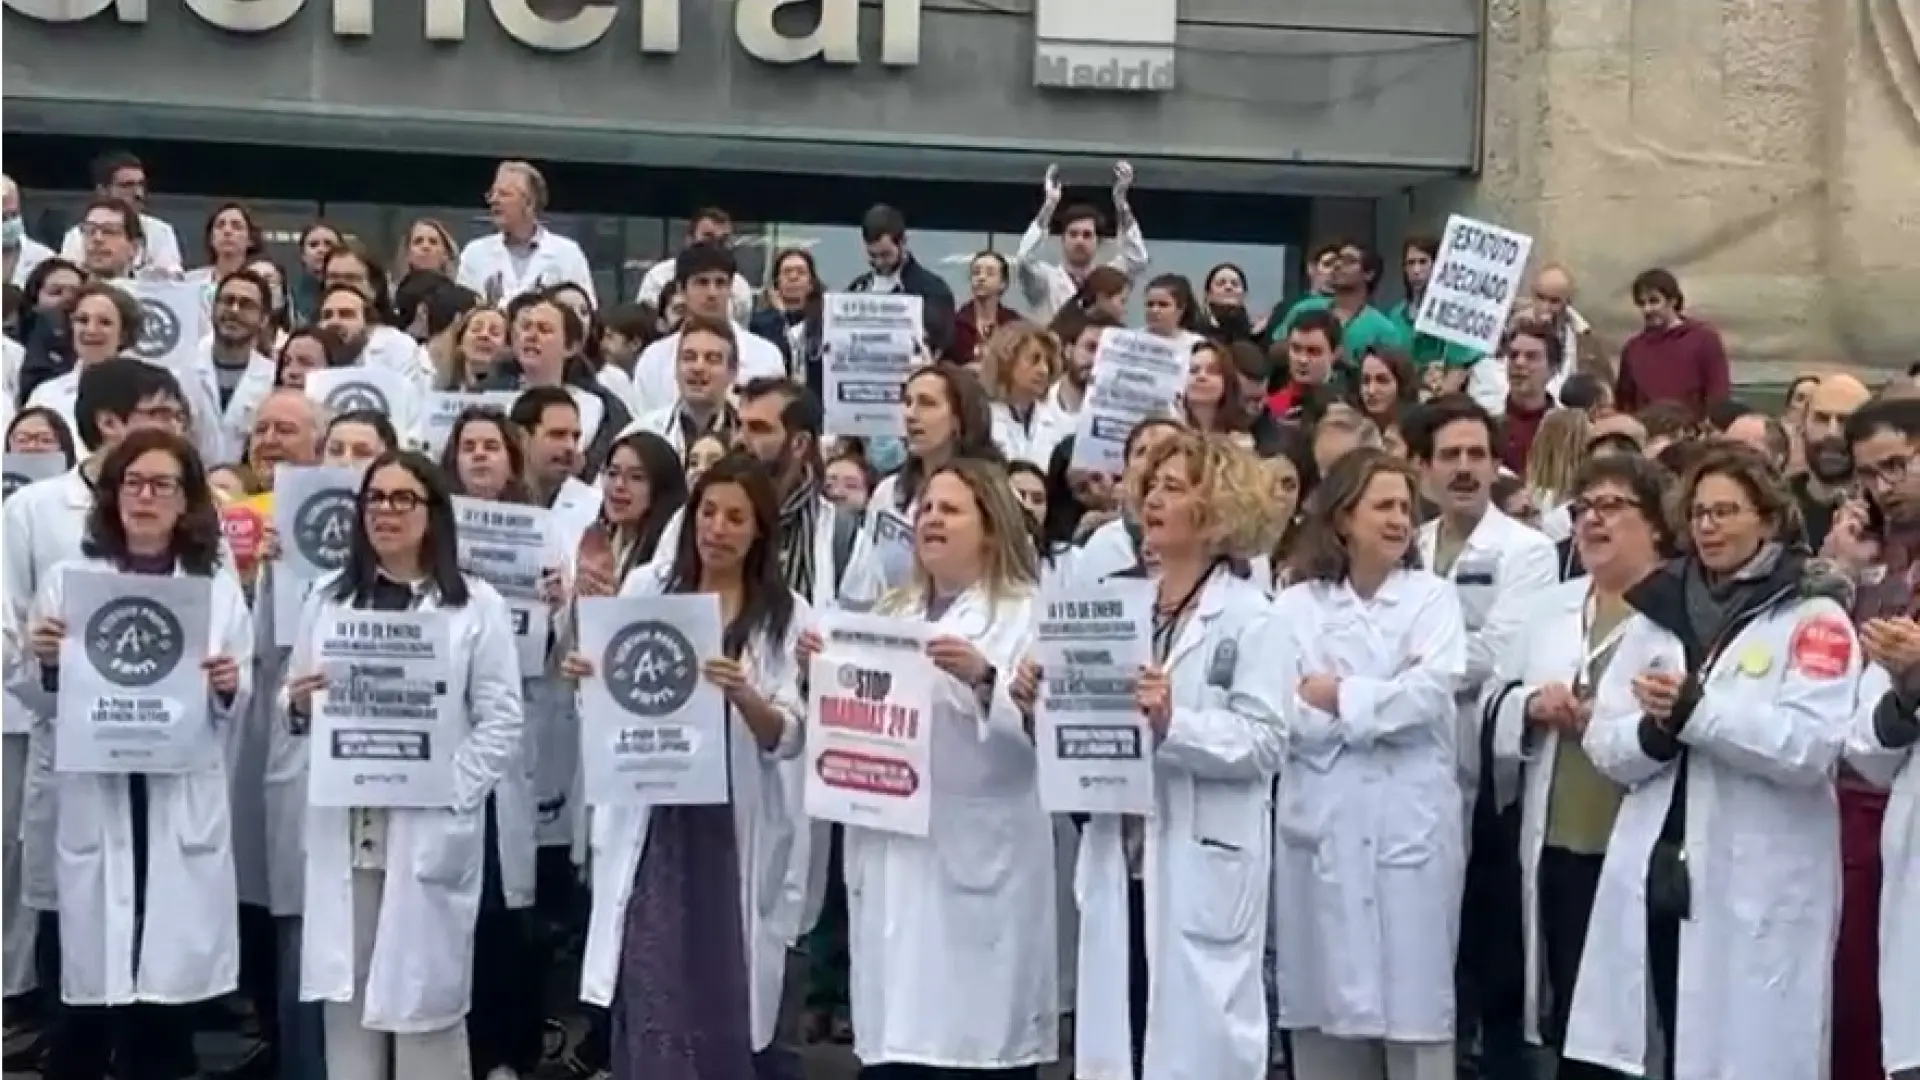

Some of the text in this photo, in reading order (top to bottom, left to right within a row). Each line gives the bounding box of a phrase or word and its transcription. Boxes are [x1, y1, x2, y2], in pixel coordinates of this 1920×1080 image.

[1036, 55, 1174, 89] Madrid
[634, 648, 671, 684] A+
[854, 667, 893, 701] STOP
